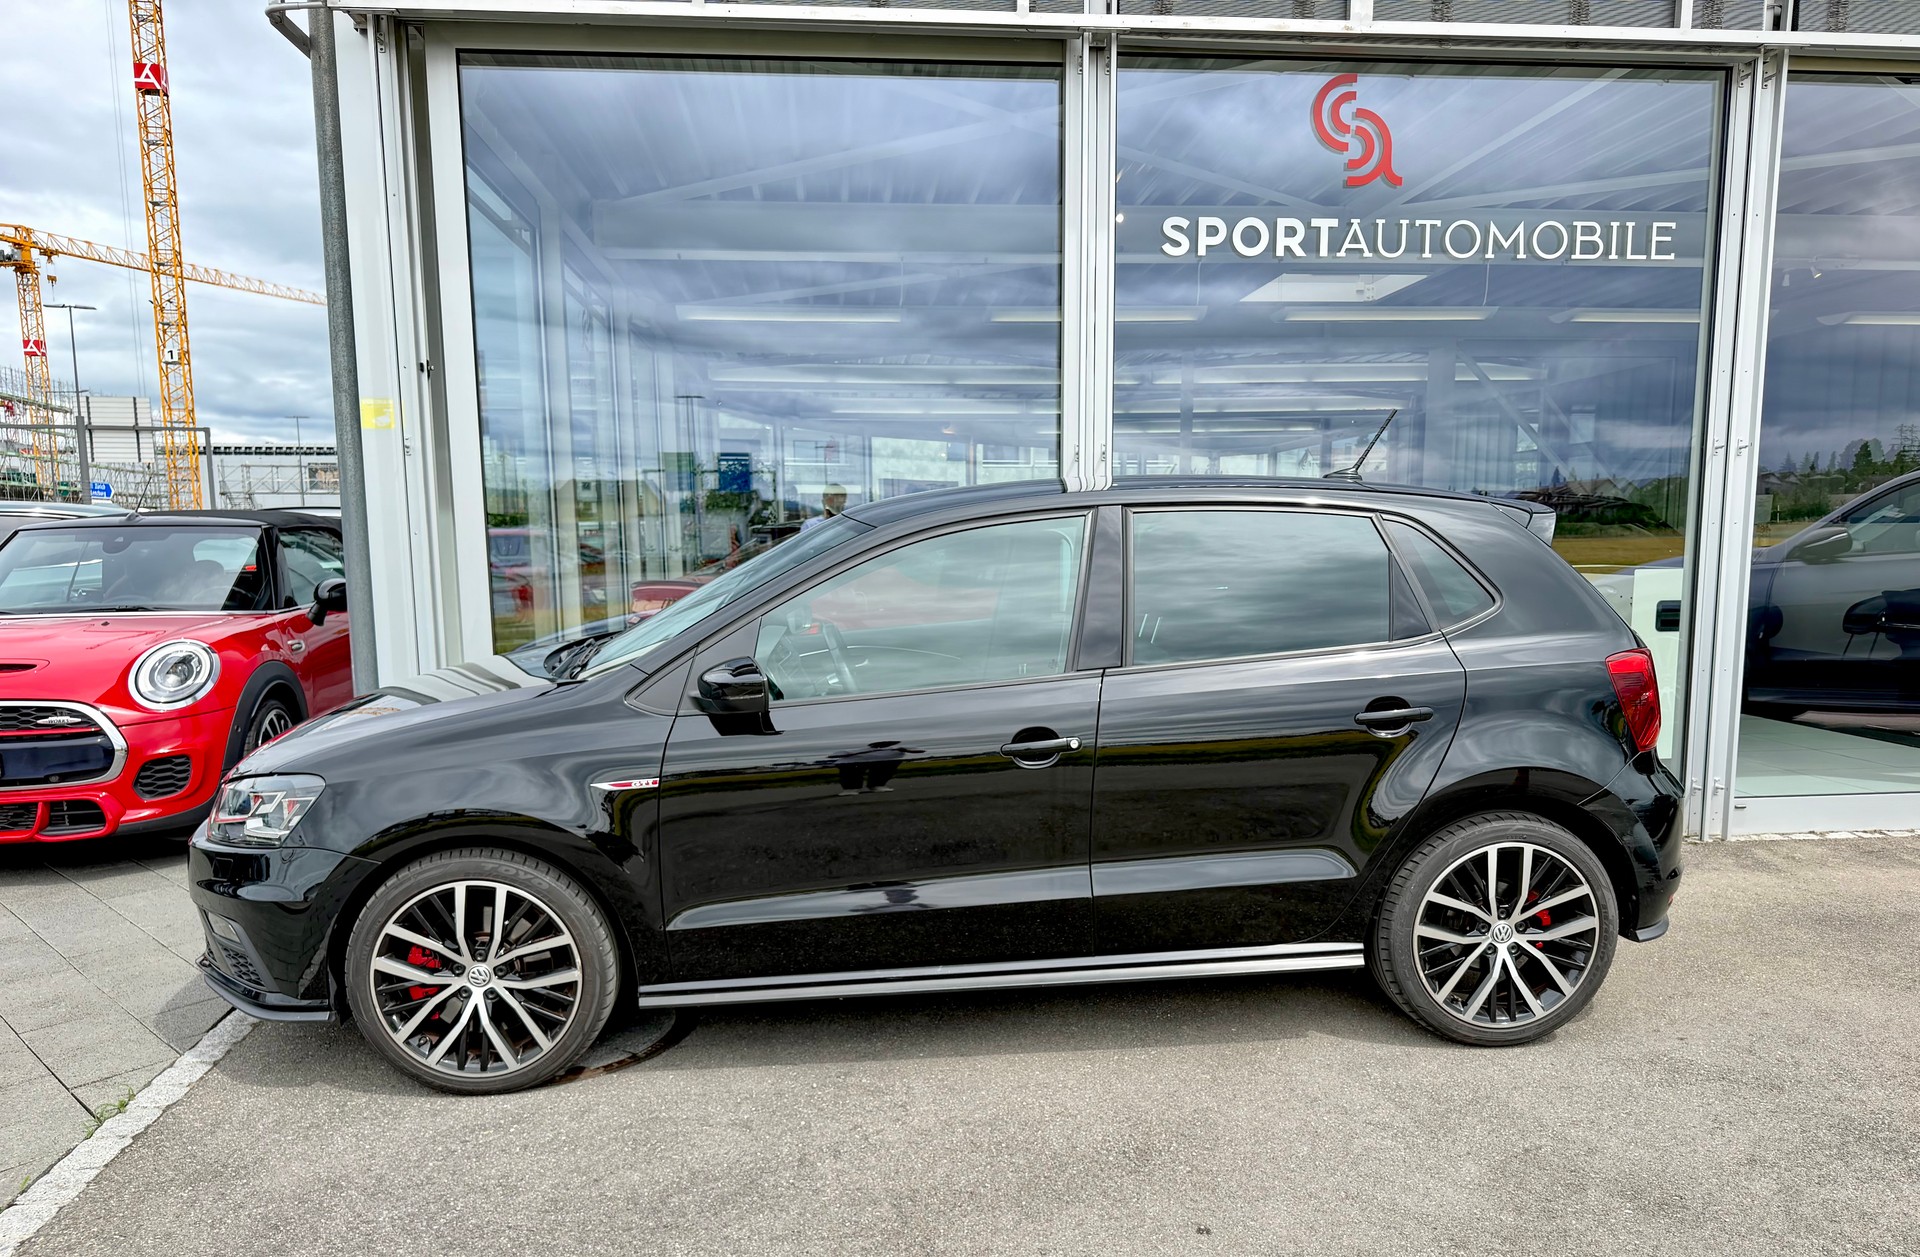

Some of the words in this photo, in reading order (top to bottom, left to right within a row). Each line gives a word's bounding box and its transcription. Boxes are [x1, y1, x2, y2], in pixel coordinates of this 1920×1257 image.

[1161, 217, 1677, 261] SPORTAUTOMOBILE
[167, 350, 173, 360] 1
[480, 862, 550, 891] TOYO
